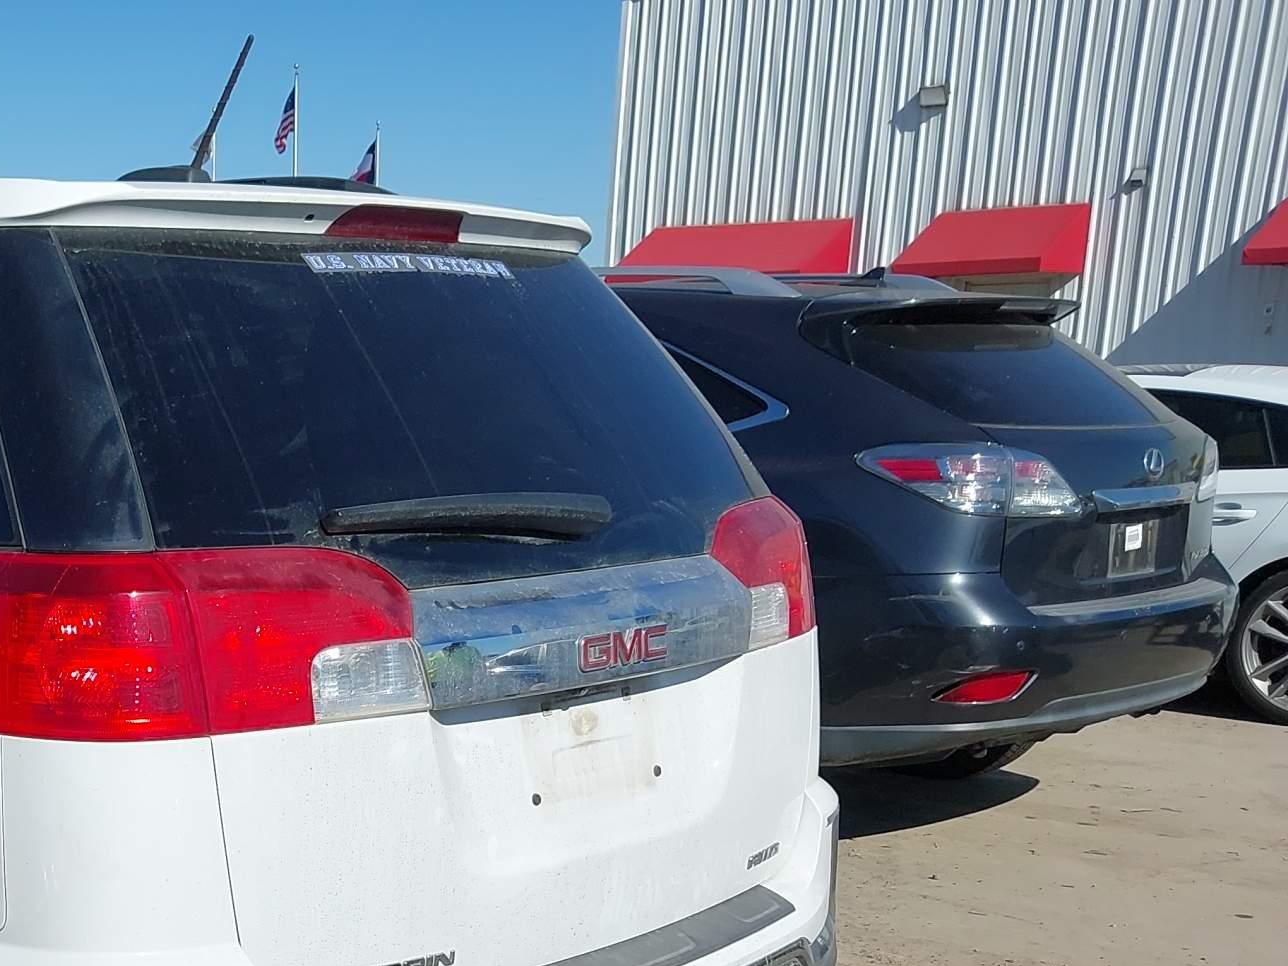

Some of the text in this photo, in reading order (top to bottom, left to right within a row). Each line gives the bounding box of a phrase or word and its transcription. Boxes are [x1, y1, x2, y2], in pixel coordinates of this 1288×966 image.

[304, 253, 512, 278] U.S. NAVY VETERAN
[578, 622, 668, 673] GMC
